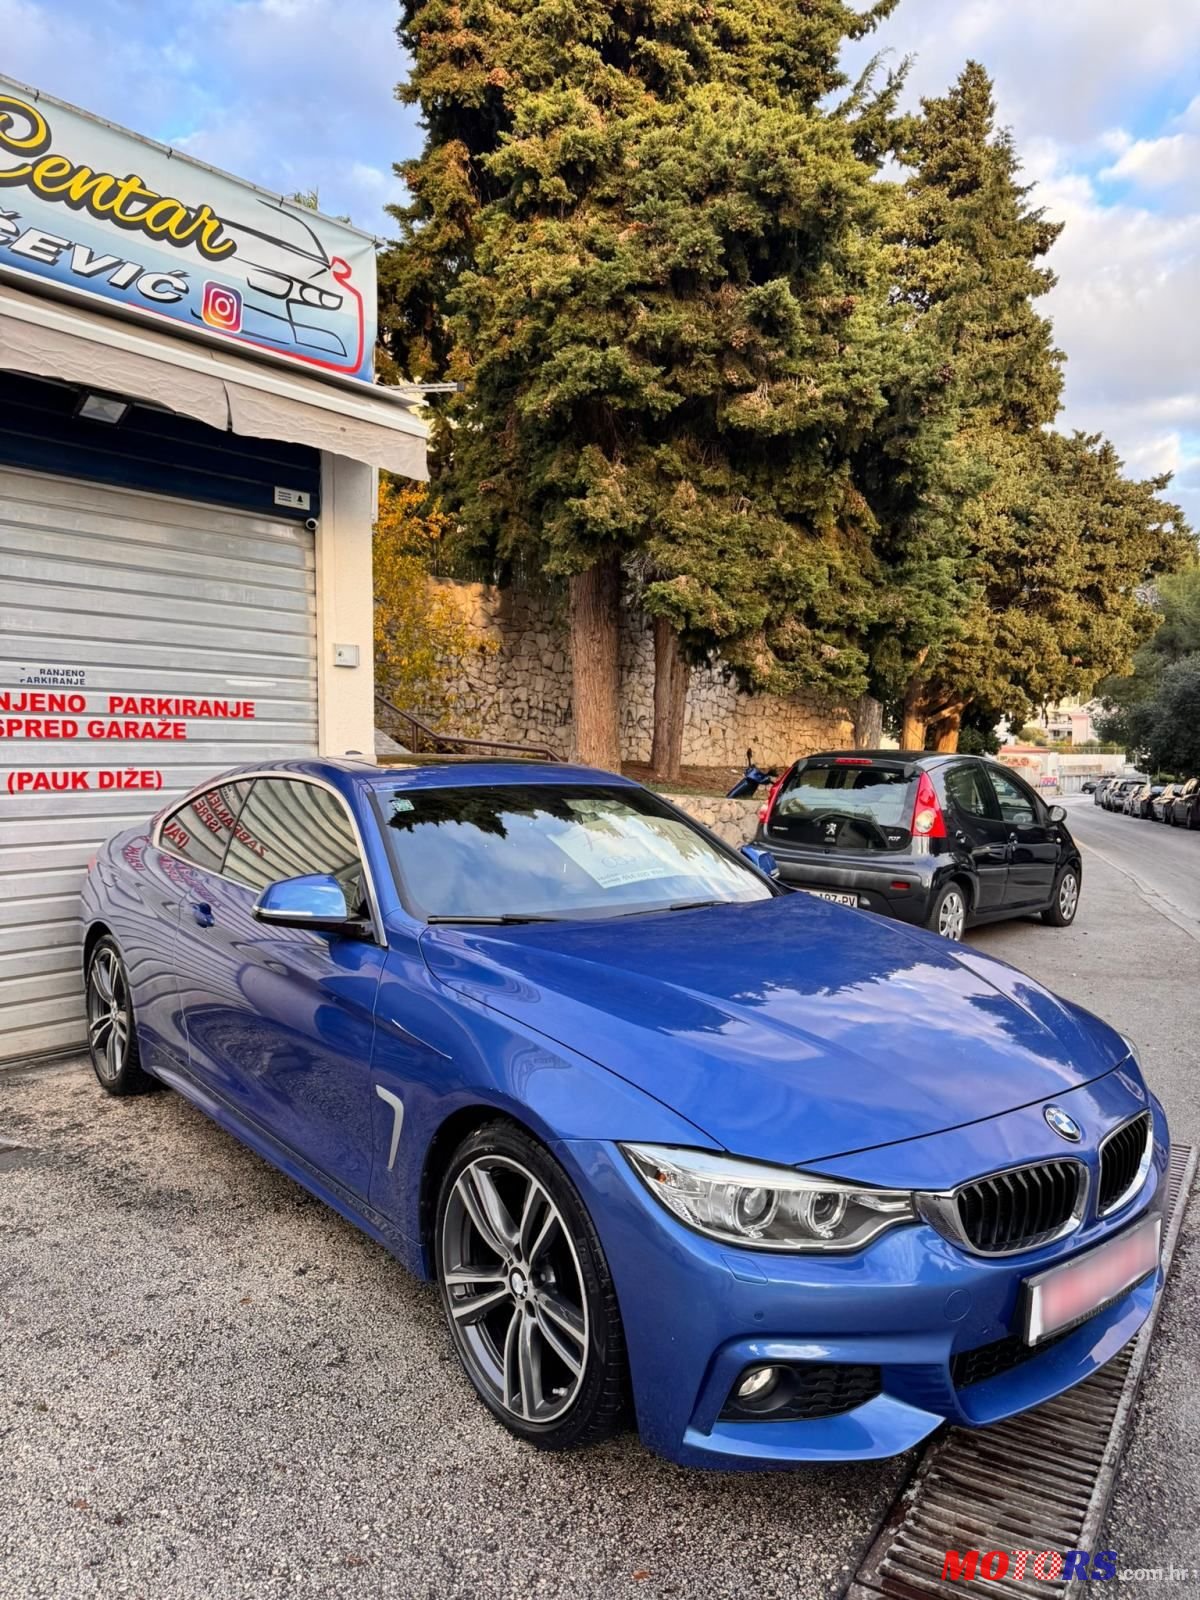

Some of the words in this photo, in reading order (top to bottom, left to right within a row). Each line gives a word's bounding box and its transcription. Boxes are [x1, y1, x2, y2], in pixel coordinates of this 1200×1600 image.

[109, 696, 255, 718] PARKIRANJE
[87, 716, 187, 740] GARAŽE
[7, 772, 90, 794] (PAUK
[99, 767, 163, 791] DIŽE)
